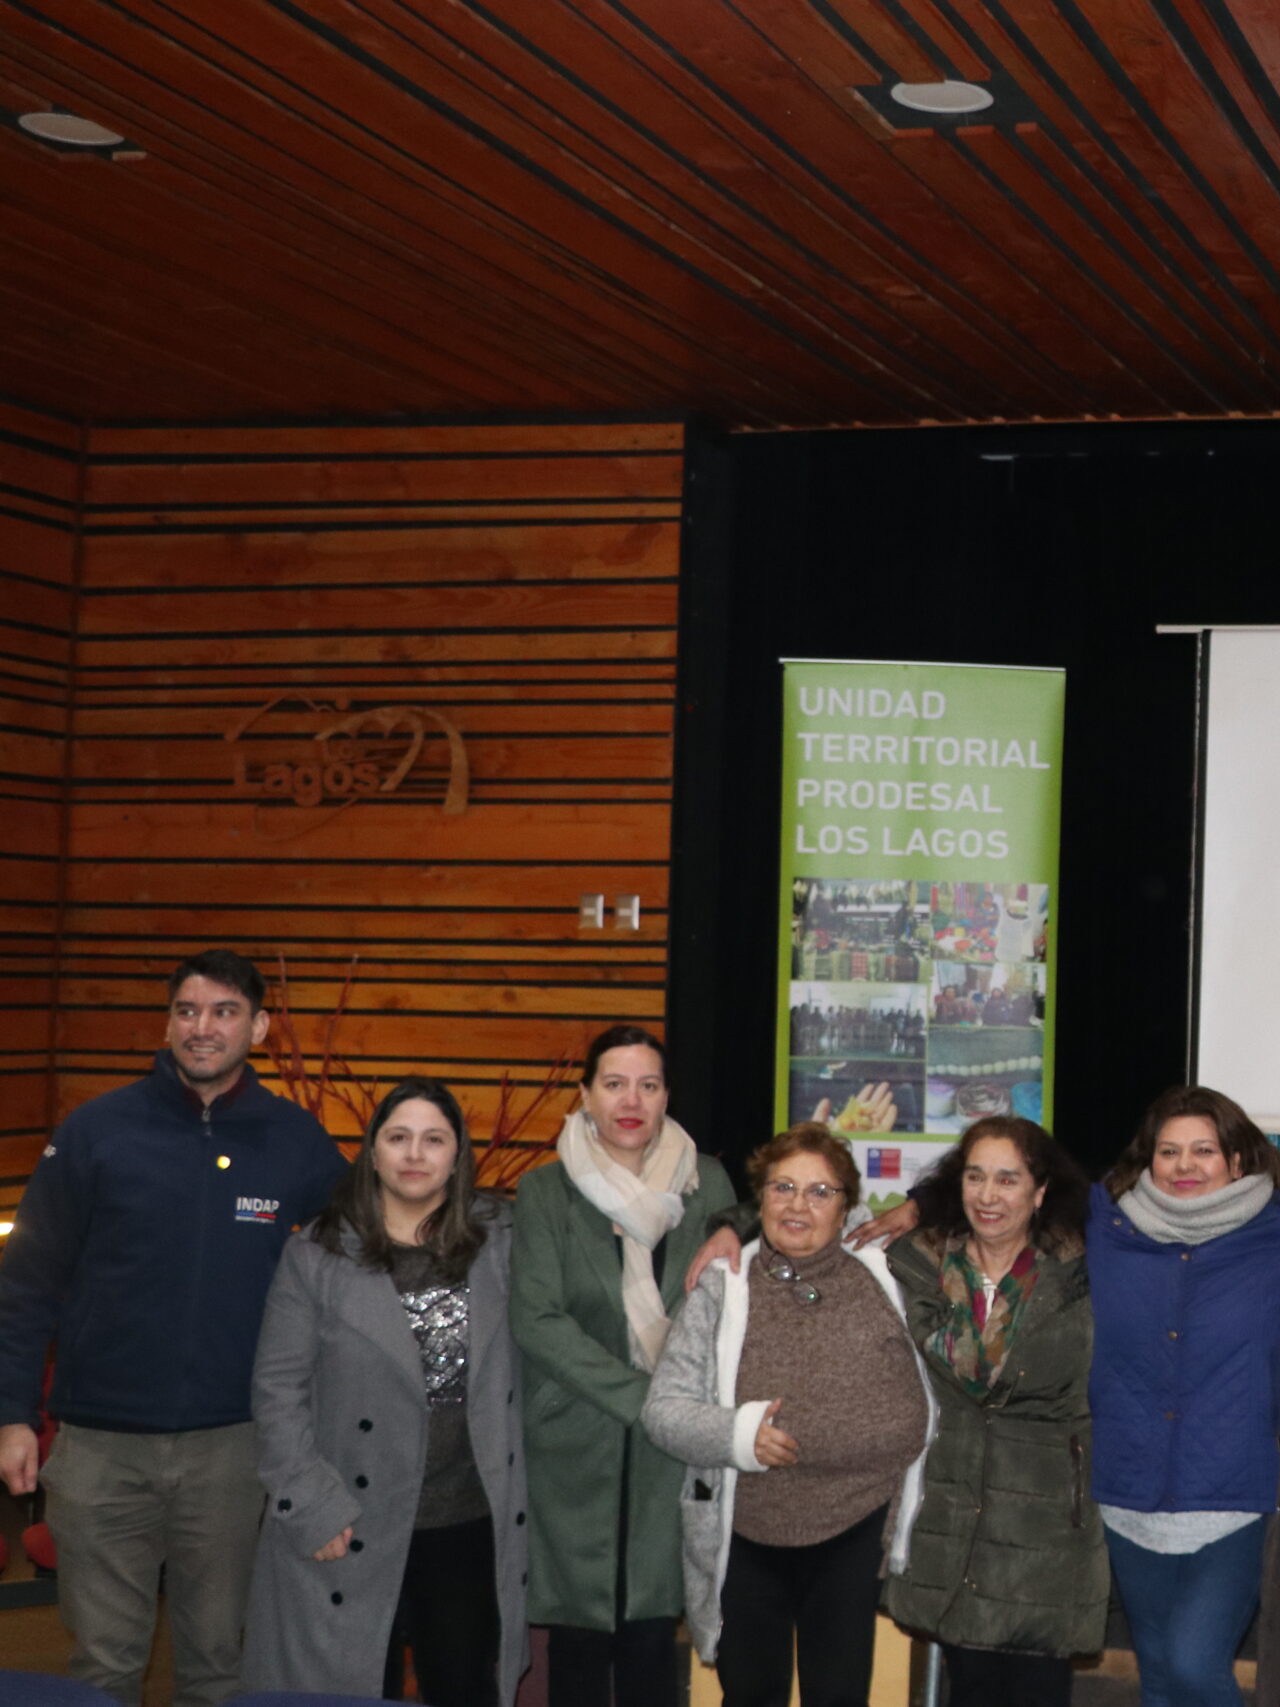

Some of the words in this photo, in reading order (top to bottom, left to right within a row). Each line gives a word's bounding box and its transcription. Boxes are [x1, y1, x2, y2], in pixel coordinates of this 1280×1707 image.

[798, 686, 946, 720] UNIDAD
[797, 733, 1051, 769] TERRITORIAL
[797, 778, 1004, 813] PRODESAL
[795, 824, 870, 855] LOS
[882, 826, 1009, 859] LAGOS
[237, 1197, 279, 1212] INDAP
